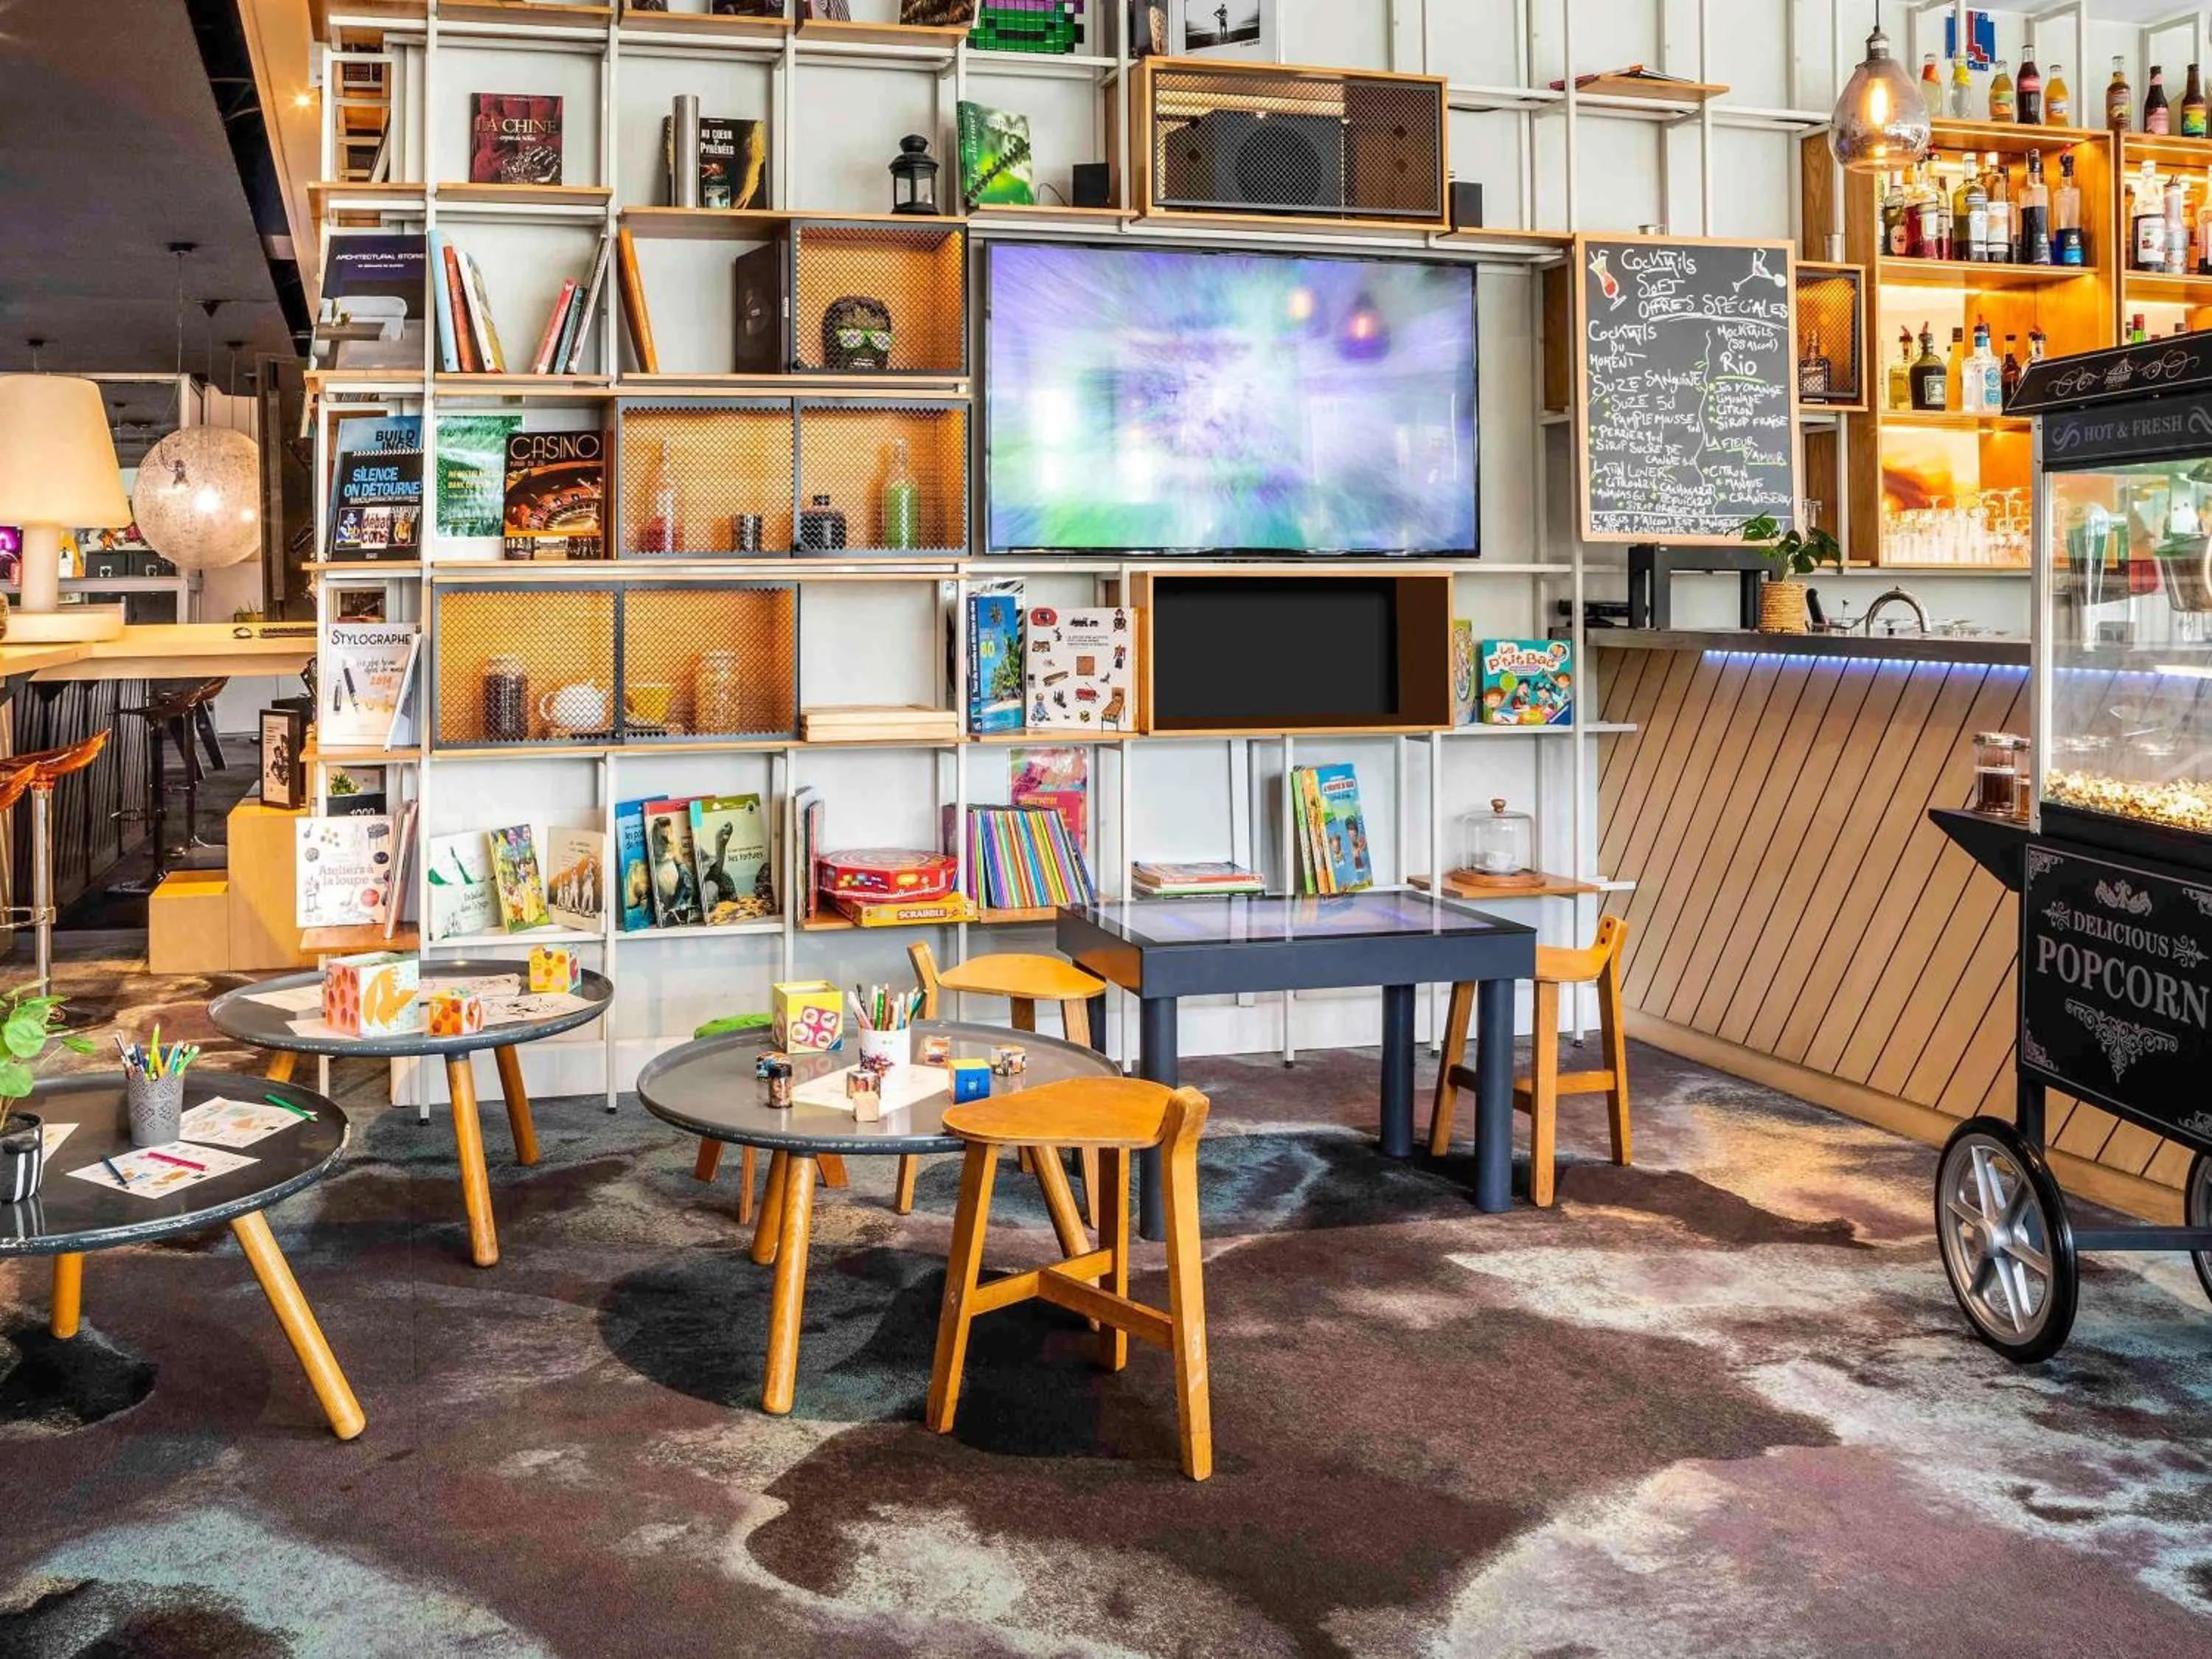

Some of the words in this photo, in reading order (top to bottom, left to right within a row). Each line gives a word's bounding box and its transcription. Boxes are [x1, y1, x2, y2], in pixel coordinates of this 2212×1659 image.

[502, 118, 557, 133] CHINE
[335, 252, 395, 260] ARCHITECTURAL
[397, 252, 425, 260] STORIE
[375, 430, 415, 442] BUILD
[2084, 425, 2114, 442] HOT
[2117, 421, 2130, 438] &
[2132, 415, 2183, 437] FRESH
[509, 434, 599, 459] CASINO
[352, 466, 399, 481] SILENCE
[331, 630, 411, 646] STYLOGRAPHE
[2073, 911, 2170, 958] DELICIOUS
[2036, 933, 2211, 1030] POPCORN
